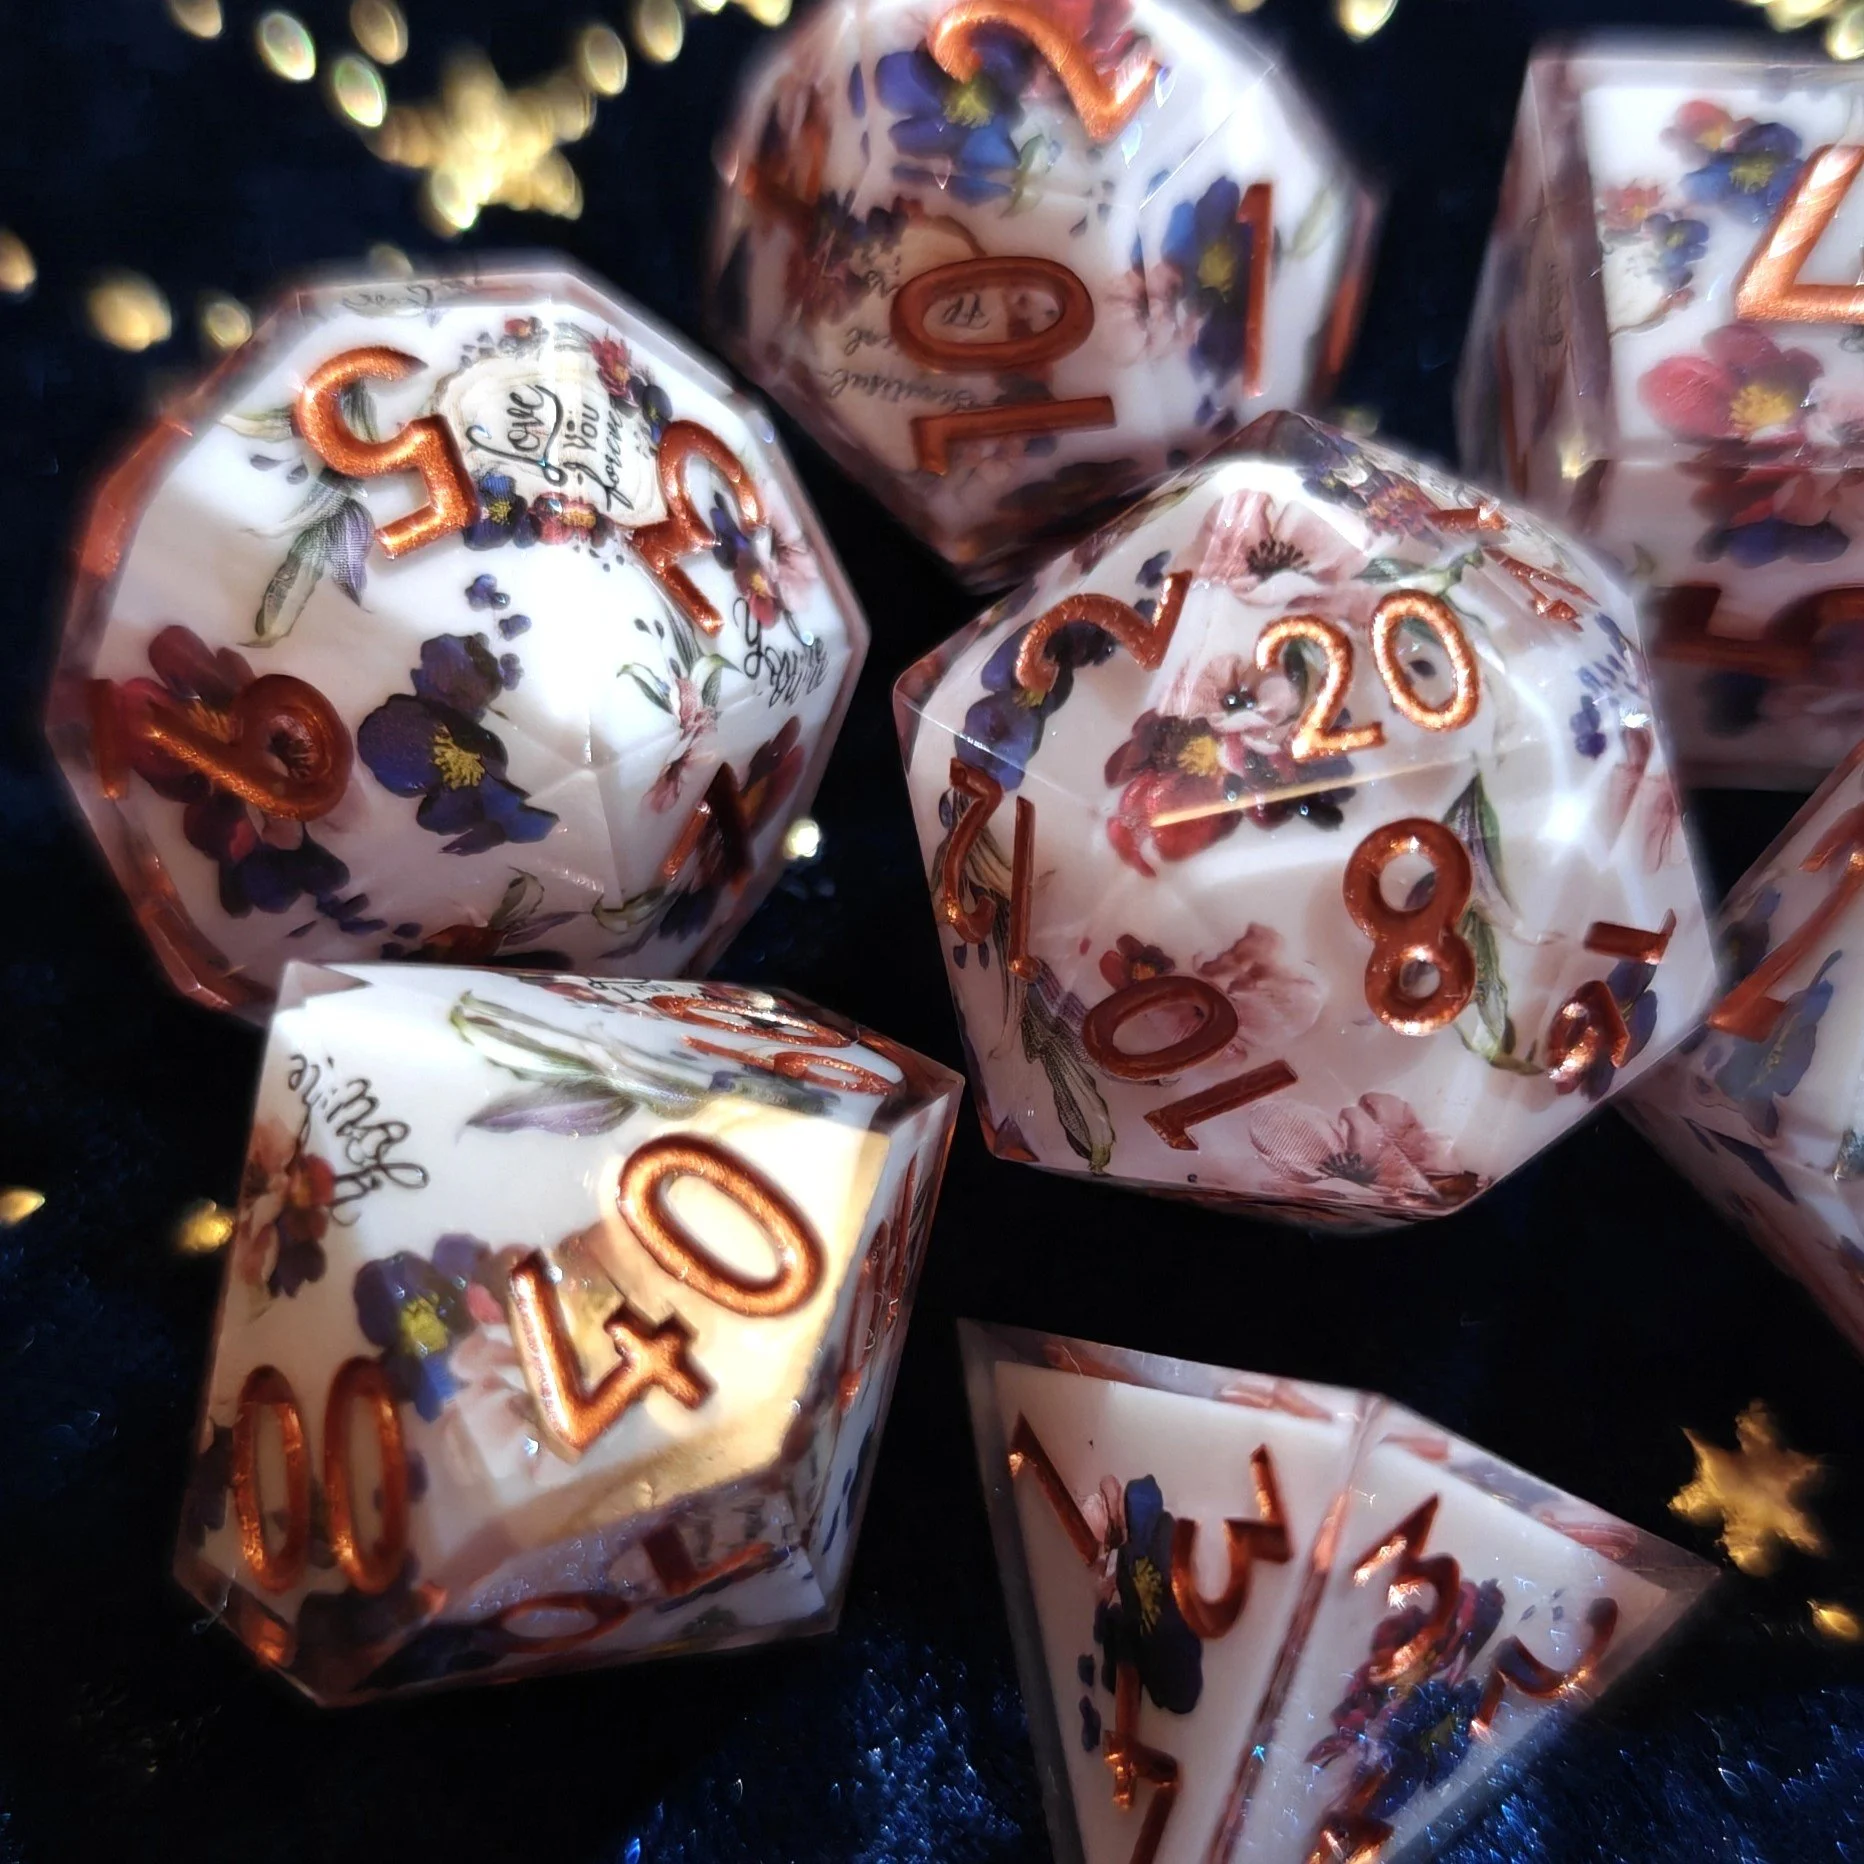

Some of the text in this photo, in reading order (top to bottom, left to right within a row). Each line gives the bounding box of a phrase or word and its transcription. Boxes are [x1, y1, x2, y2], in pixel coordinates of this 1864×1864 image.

[927, 0, 1162, 142] 2
[293, 343, 481, 560] 5
[466, 385, 568, 487] Love
[891, 255, 1117, 476] 10
[1017, 570, 1190, 693] 2
[1256, 587, 1480, 762] 20
[1343, 816, 1477, 1036] 8
[1082, 975, 1298, 1151] 10
[508, 1131, 829, 1456] 40
[230, 1356, 411, 1597] 00
